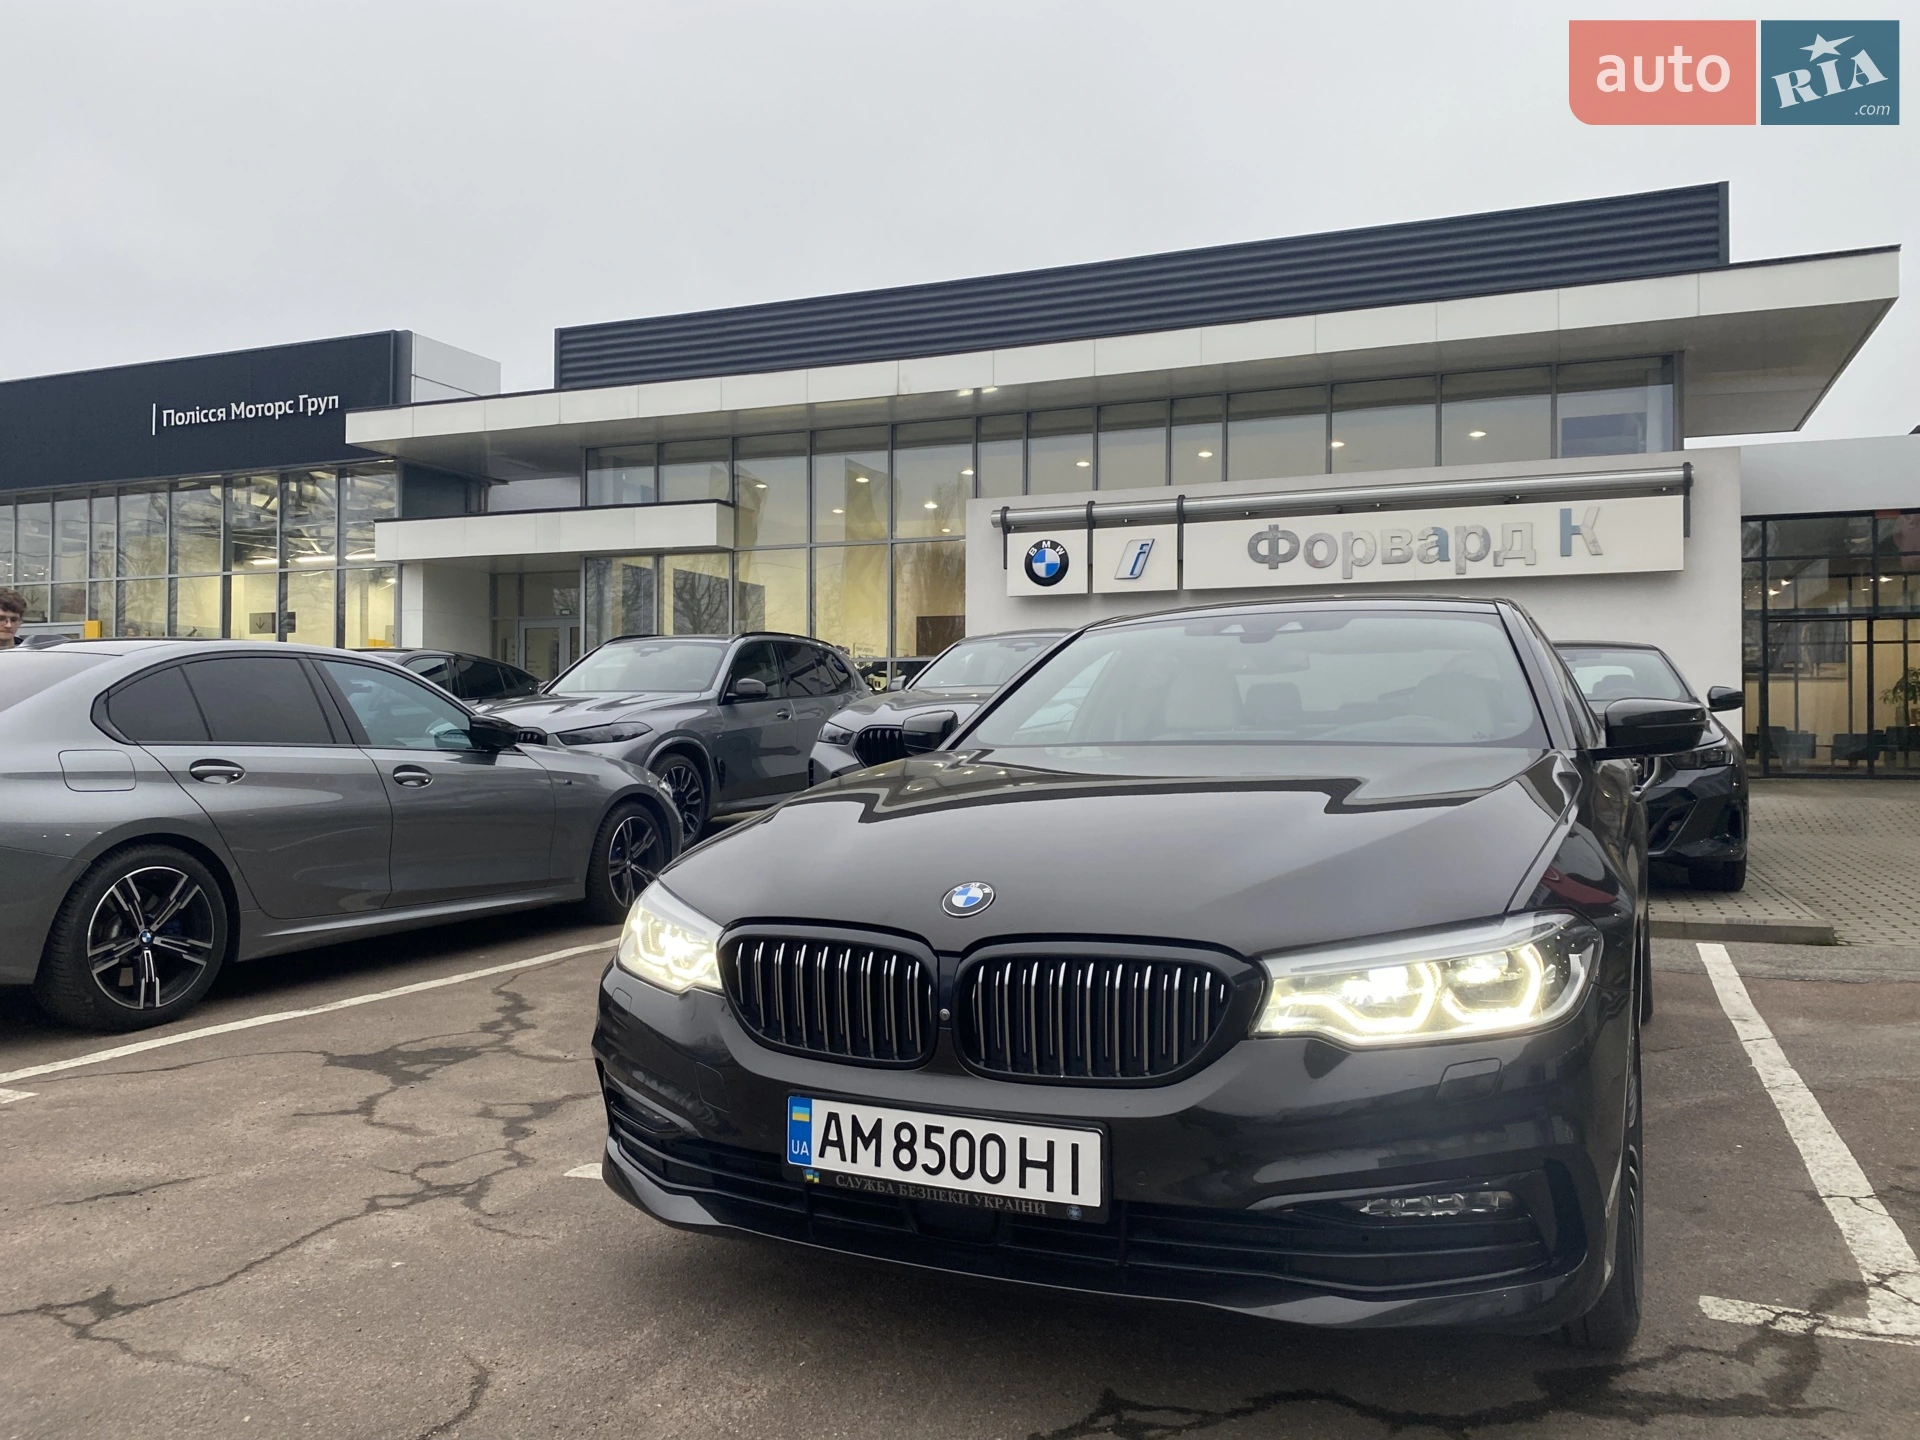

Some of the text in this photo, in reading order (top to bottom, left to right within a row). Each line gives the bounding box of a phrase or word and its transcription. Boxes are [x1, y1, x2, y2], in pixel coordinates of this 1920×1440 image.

[162, 394, 339, 427] Полісся Моторс Груп
[1028, 540, 1066, 557] BMW
[1246, 523, 1537, 580] Форвард
[791, 1140, 809, 1157] UA
[835, 1174, 1047, 1216] СЛУЖБА БЕЗПЕКИ УКРАЇНИ
